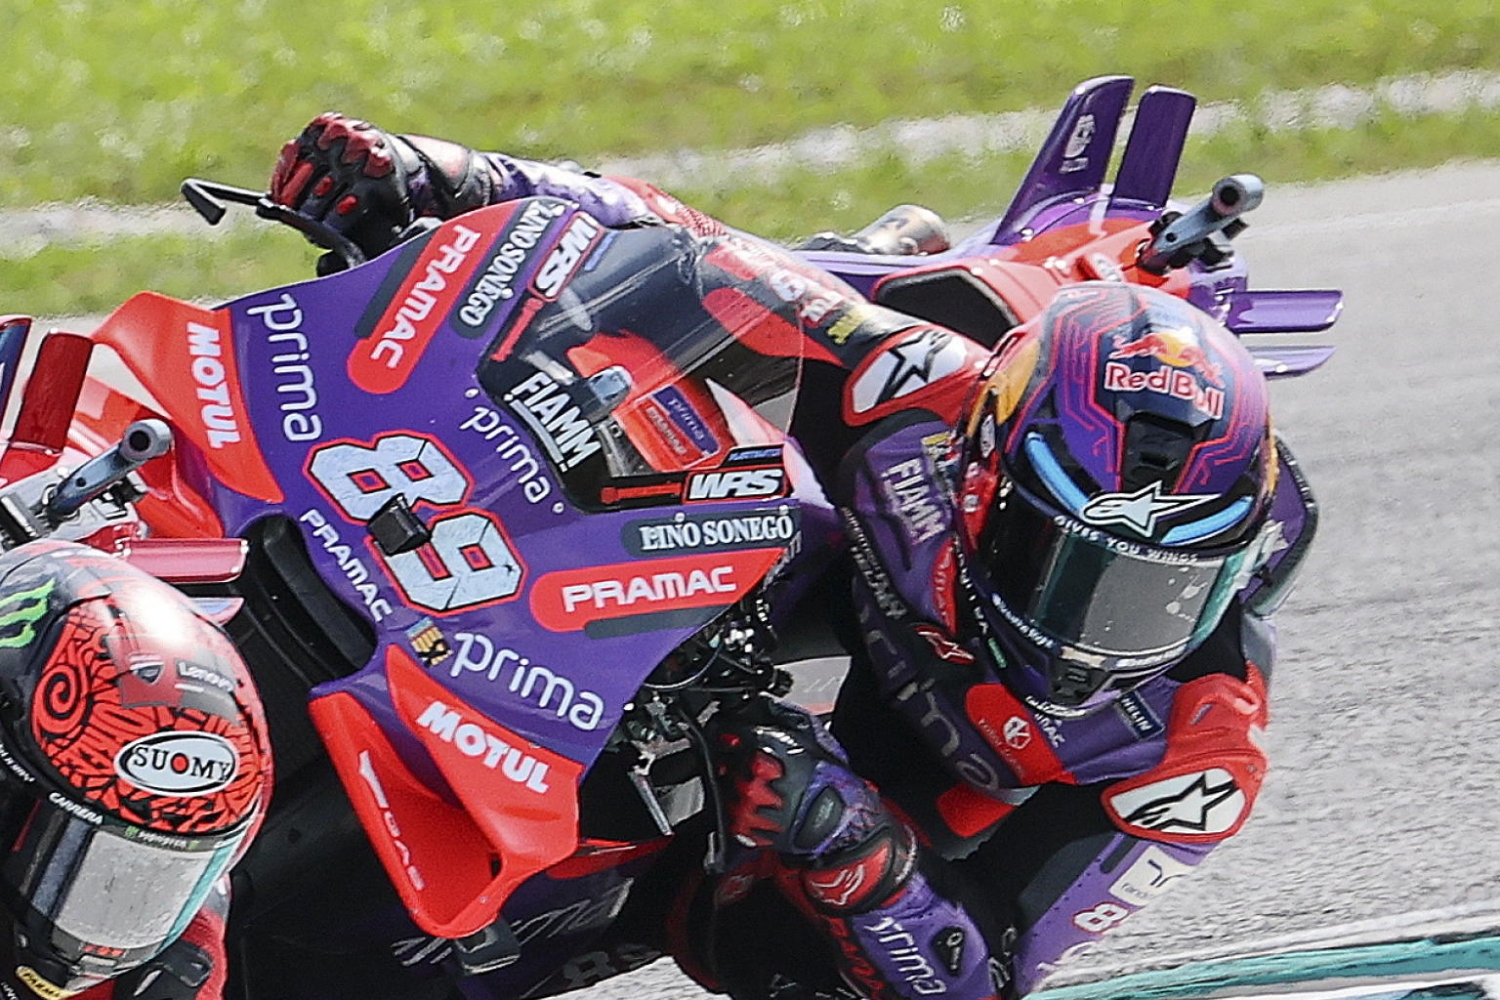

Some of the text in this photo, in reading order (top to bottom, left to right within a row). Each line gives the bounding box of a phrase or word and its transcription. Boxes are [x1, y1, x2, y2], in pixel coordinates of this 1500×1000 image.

[370, 224, 481, 368] PRAMAC
[459, 243, 527, 327] SONEGO
[535, 217, 598, 297] WRS
[187, 322, 241, 449] MOTUL
[247, 293, 323, 442] prima
[1104, 362, 1226, 420] Red Bull
[460, 407, 552, 503] prima
[510, 371, 600, 468] FIAMM
[304, 432, 527, 613] 89
[689, 469, 783, 499] WRS
[886, 458, 946, 545] FIAMM
[301, 509, 394, 623] PRAMAC
[702, 515, 794, 546] SONEGO
[1054, 515, 1198, 564] GIVES YOU WINGS
[562, 566, 738, 613] PRAMAC
[449, 631, 604, 731] prima
[133, 747, 231, 784] SUOMY
[417, 701, 551, 794] MOTUL
[49, 792, 103, 825] CARRERA
